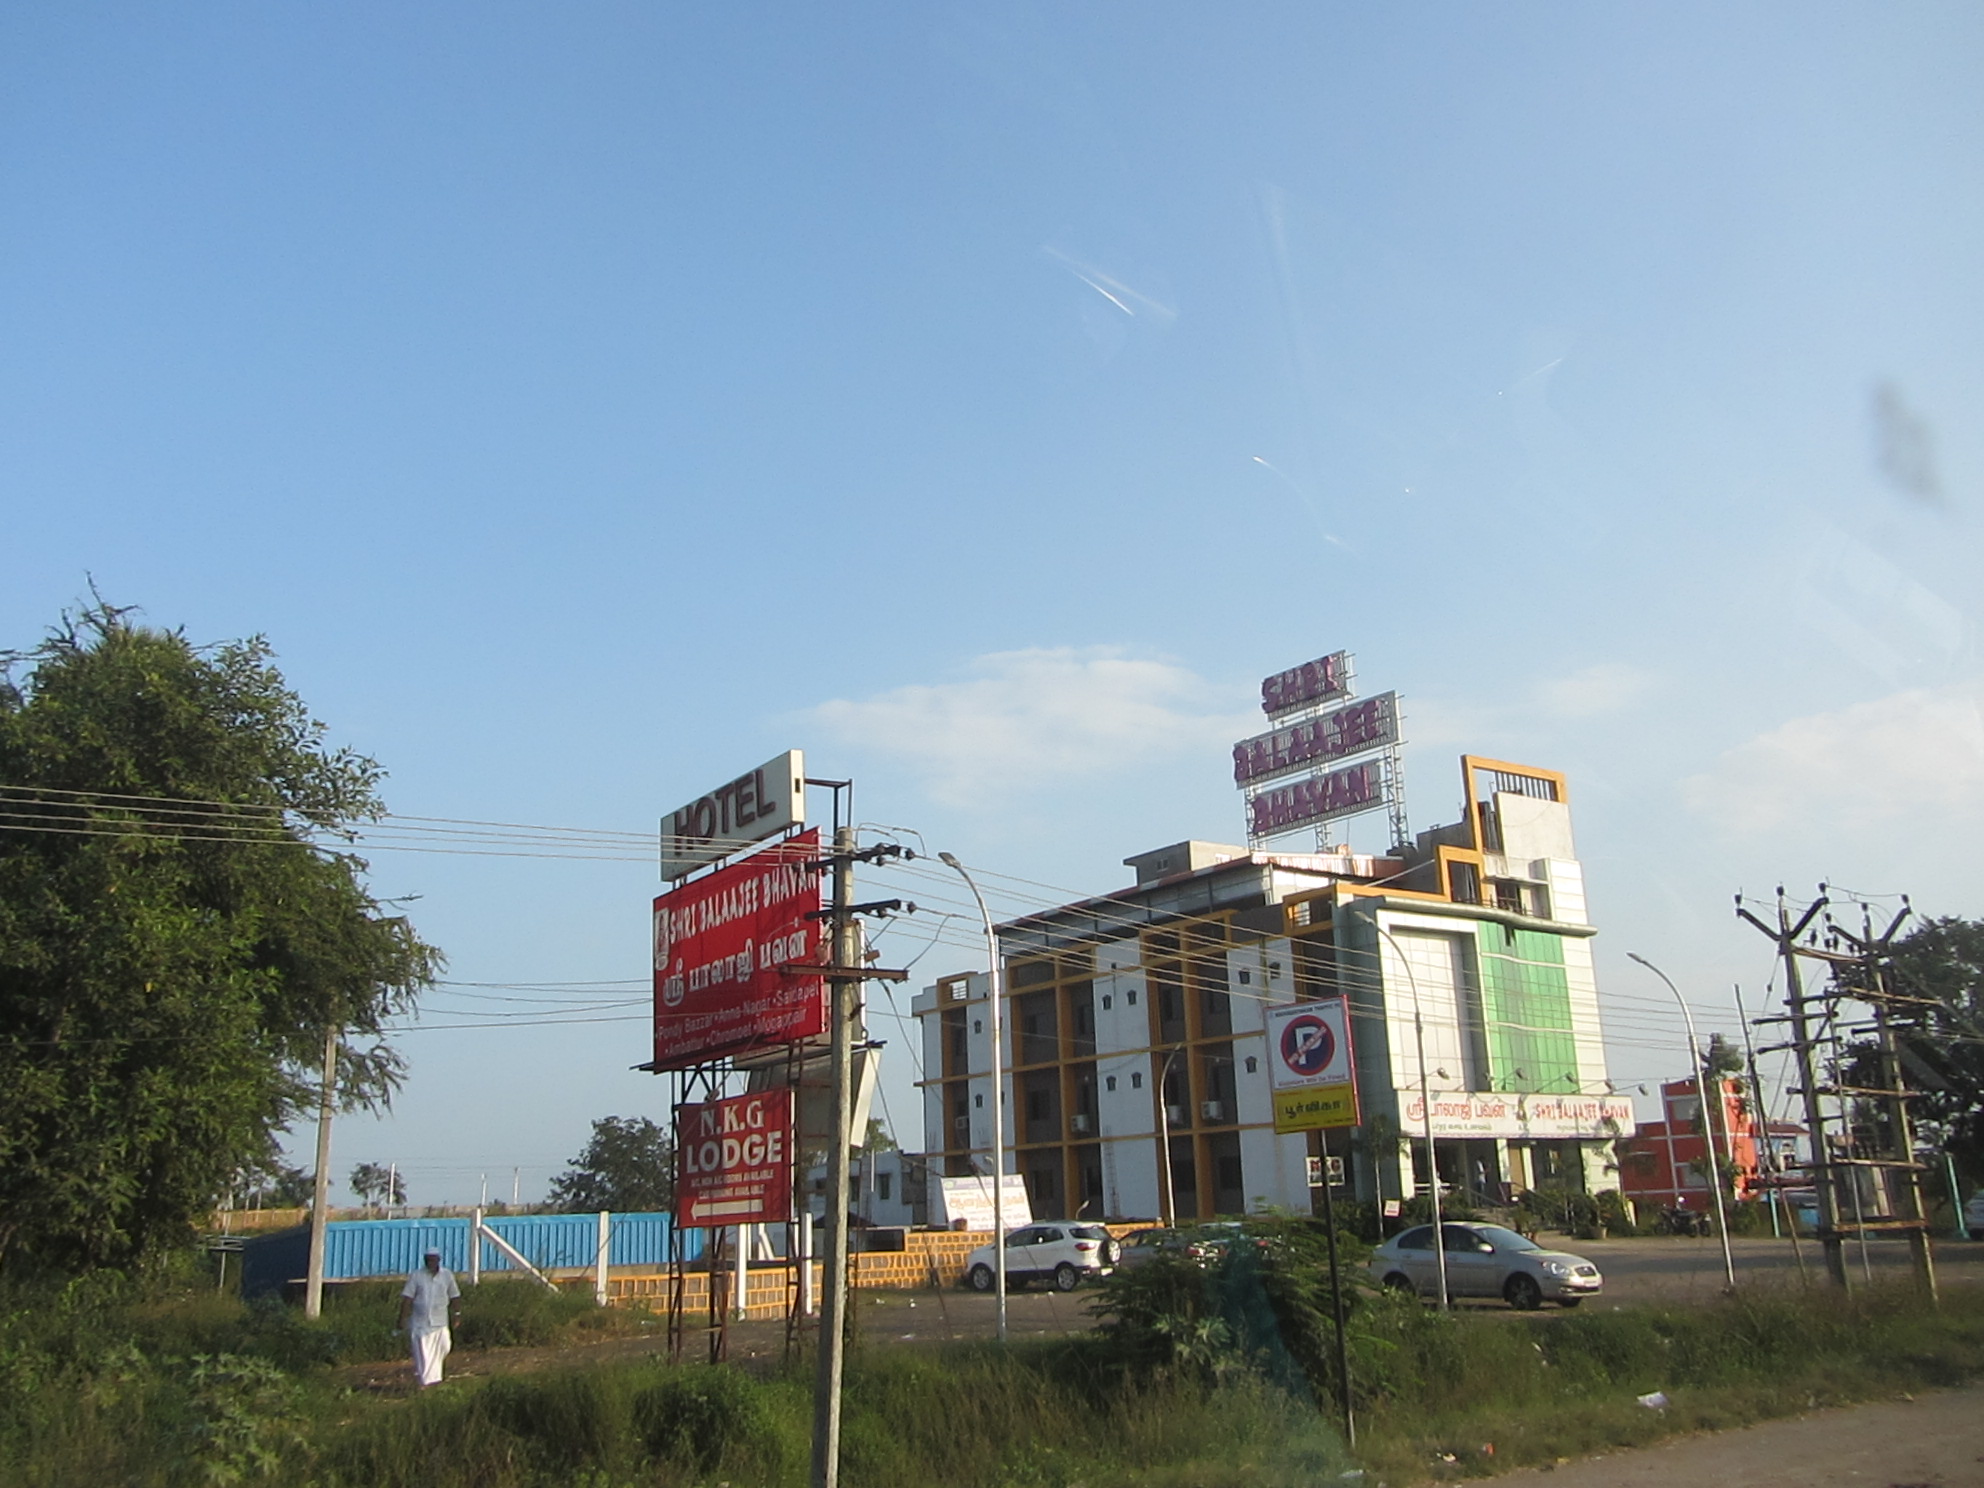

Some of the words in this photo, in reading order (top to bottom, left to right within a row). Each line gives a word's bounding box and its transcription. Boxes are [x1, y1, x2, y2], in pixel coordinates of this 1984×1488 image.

[1262, 655, 1339, 713] SHRI
[674, 769, 777, 856] HOTEL
[1252, 765, 1370, 834] BHAVAN
[670, 904, 696, 944] SHRI
[700, 878, 759, 934] BALAAJEE
[763, 855, 817, 908] BHAVAN
[690, 938, 754, 993] பாலாஜி
[759, 916, 809, 969] பவன்
[686, 1130, 782, 1174] LODGE
[701, 1100, 765, 1137] N.K.G
